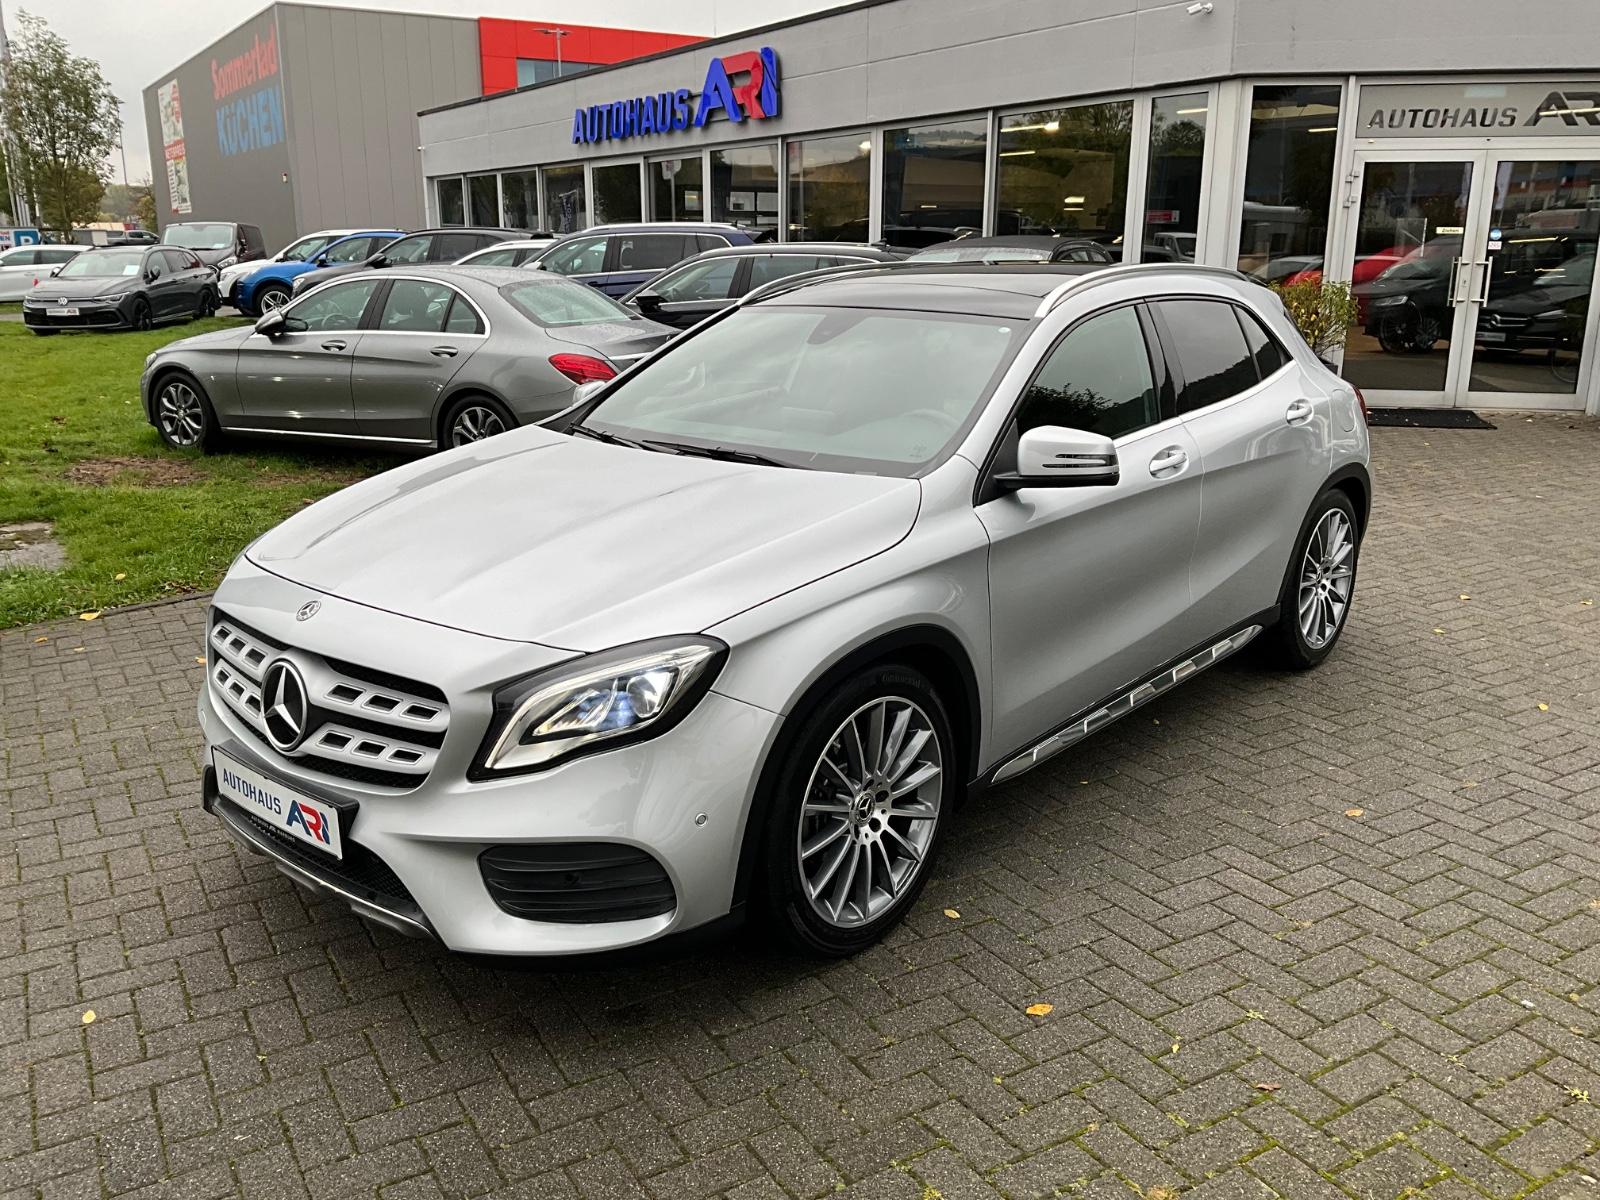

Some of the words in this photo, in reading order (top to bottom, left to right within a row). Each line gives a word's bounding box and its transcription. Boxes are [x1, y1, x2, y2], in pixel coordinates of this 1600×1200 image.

[211, 23, 278, 100] Sommerlad
[216, 82, 284, 156] KÜCHEN
[572, 89, 690, 144] AUTOHAUS
[1367, 107, 1518, 129] AUTOHAUS
[223, 768, 282, 815] AUTOHAUS
